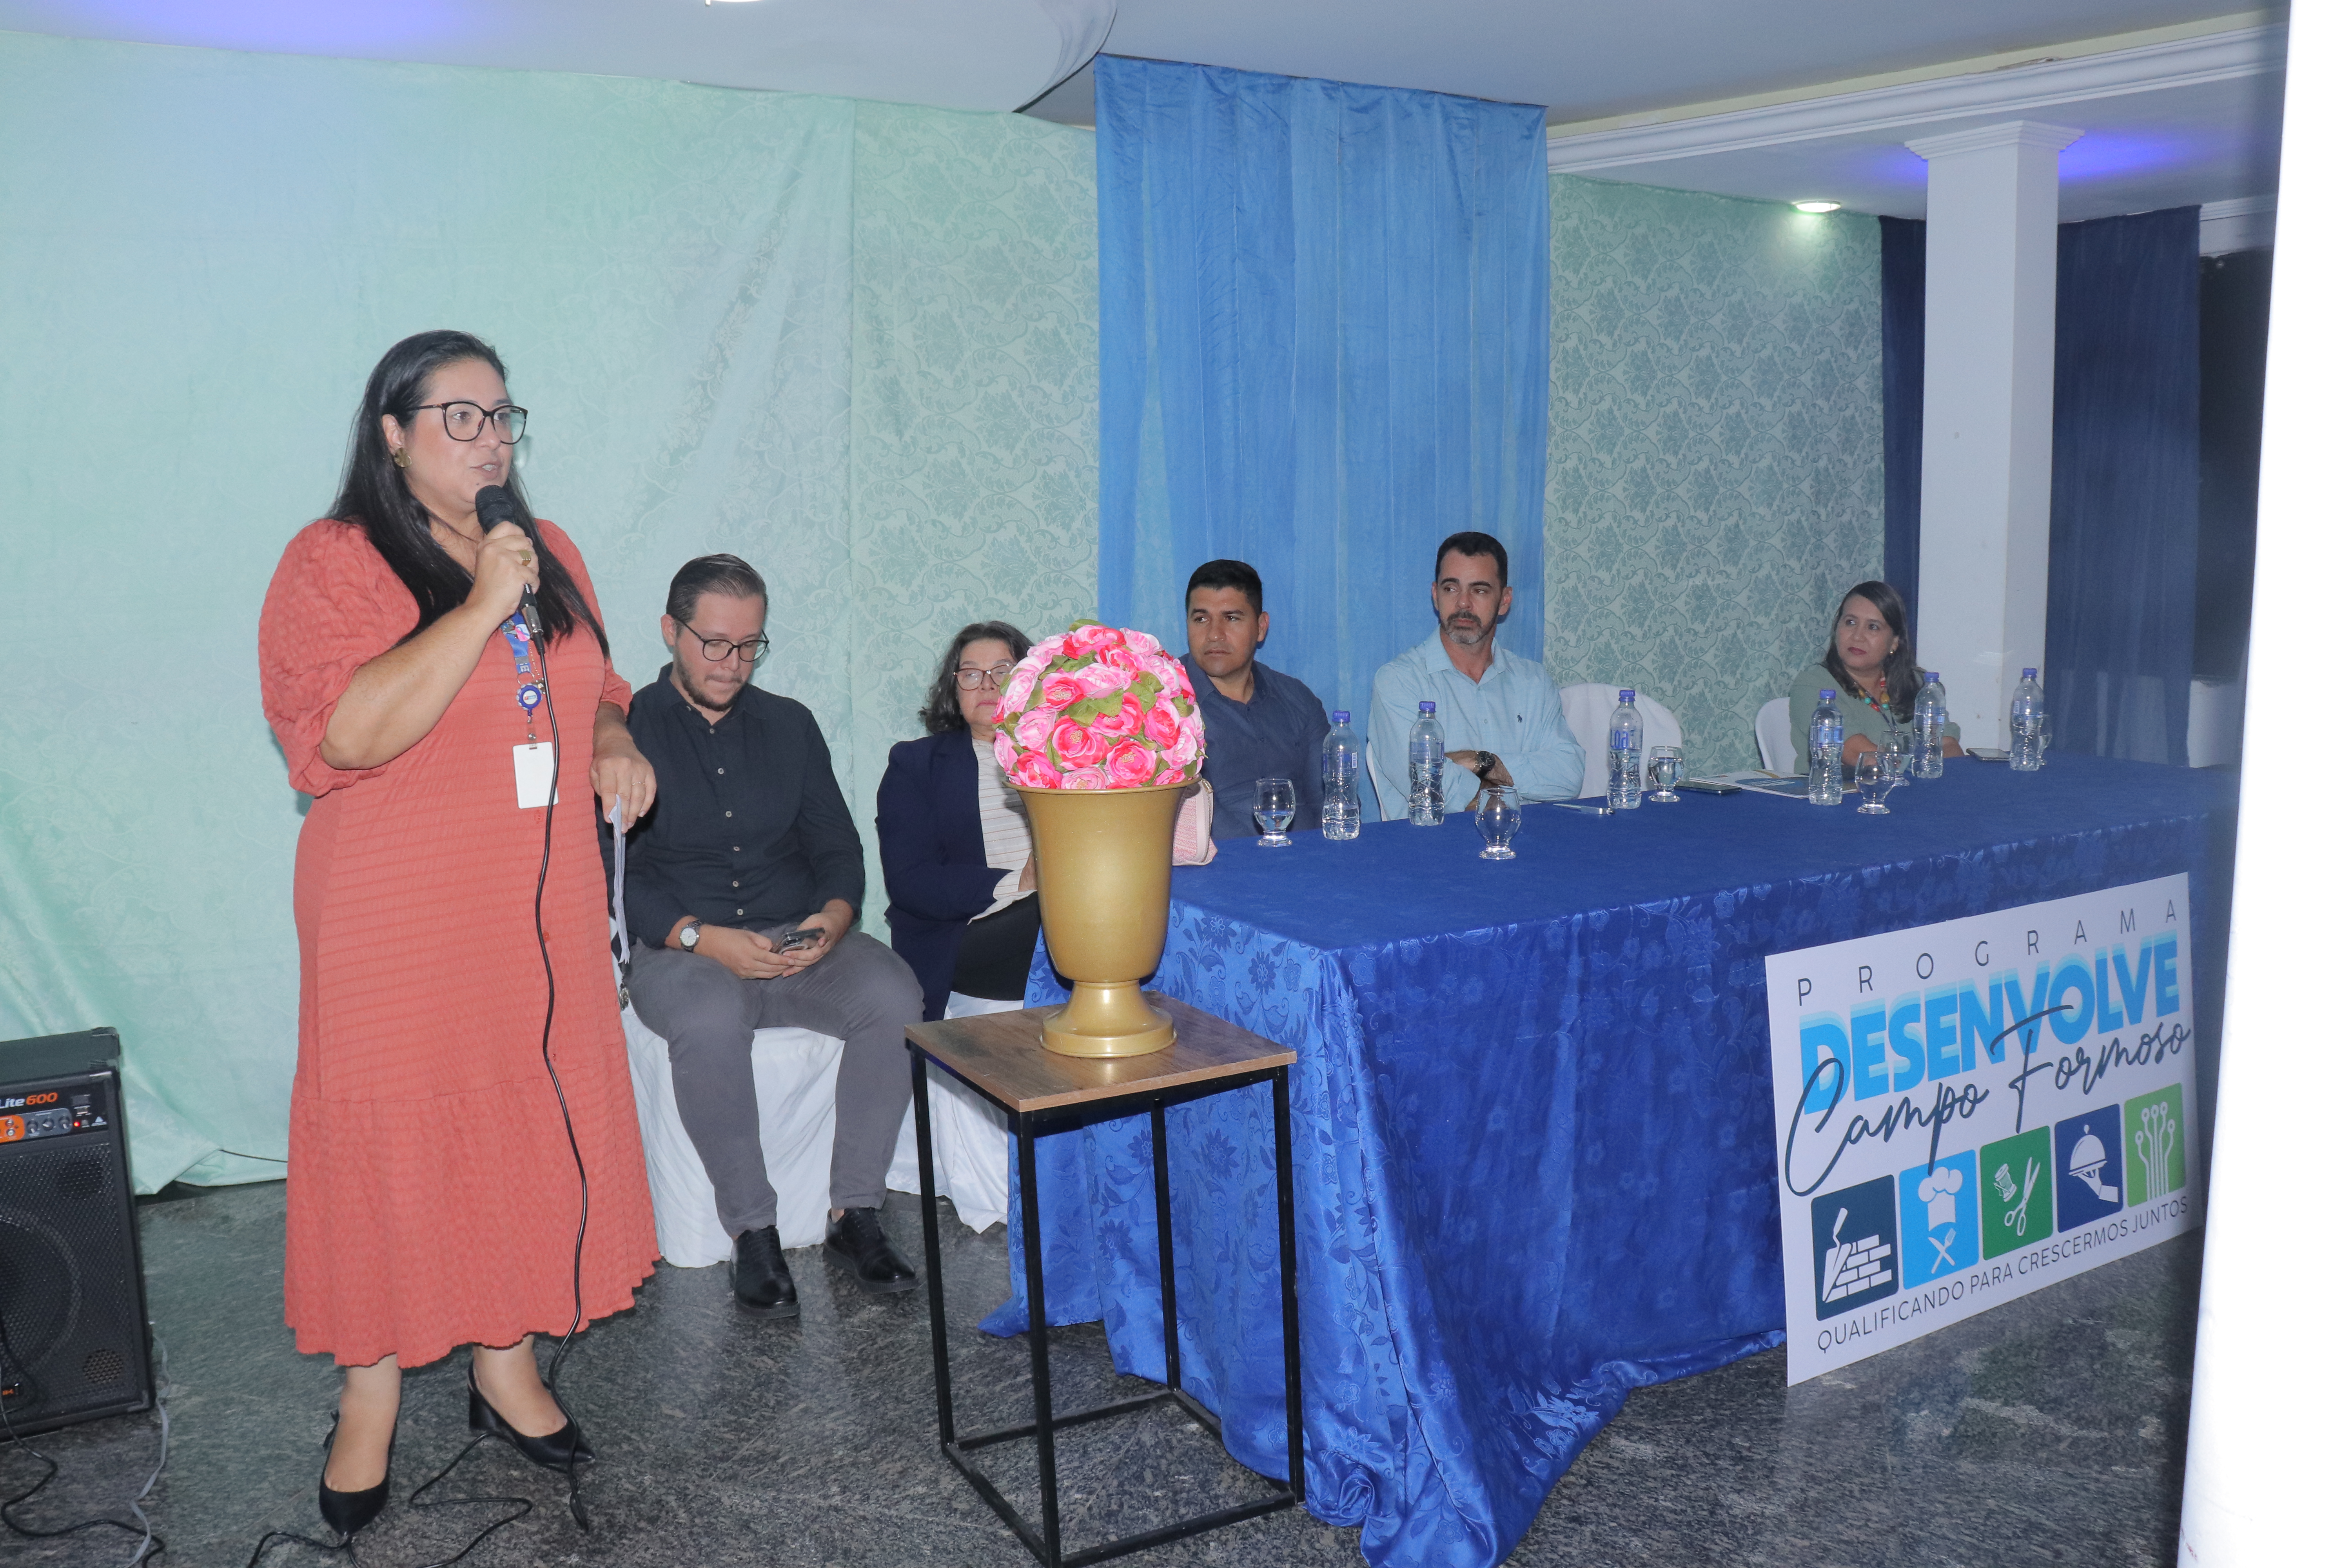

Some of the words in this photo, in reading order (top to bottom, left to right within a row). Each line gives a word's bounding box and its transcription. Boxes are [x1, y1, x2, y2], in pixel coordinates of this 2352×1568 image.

[1797, 899, 2176, 1006] PROGRAMA
[1799, 928, 2180, 1115] DESENVOLVE
[26, 1092, 58, 1105] 600
[1785, 1058, 1989, 1197] Campo
[1989, 1005, 2191, 1134] Formoso
[1818, 1281, 1964, 1353] QUALIFICANDO
[1971, 1263, 2013, 1294] PARA
[2018, 1220, 2128, 1274] CRESCERMOS
[2132, 1196, 2187, 1233] JUNTOS
